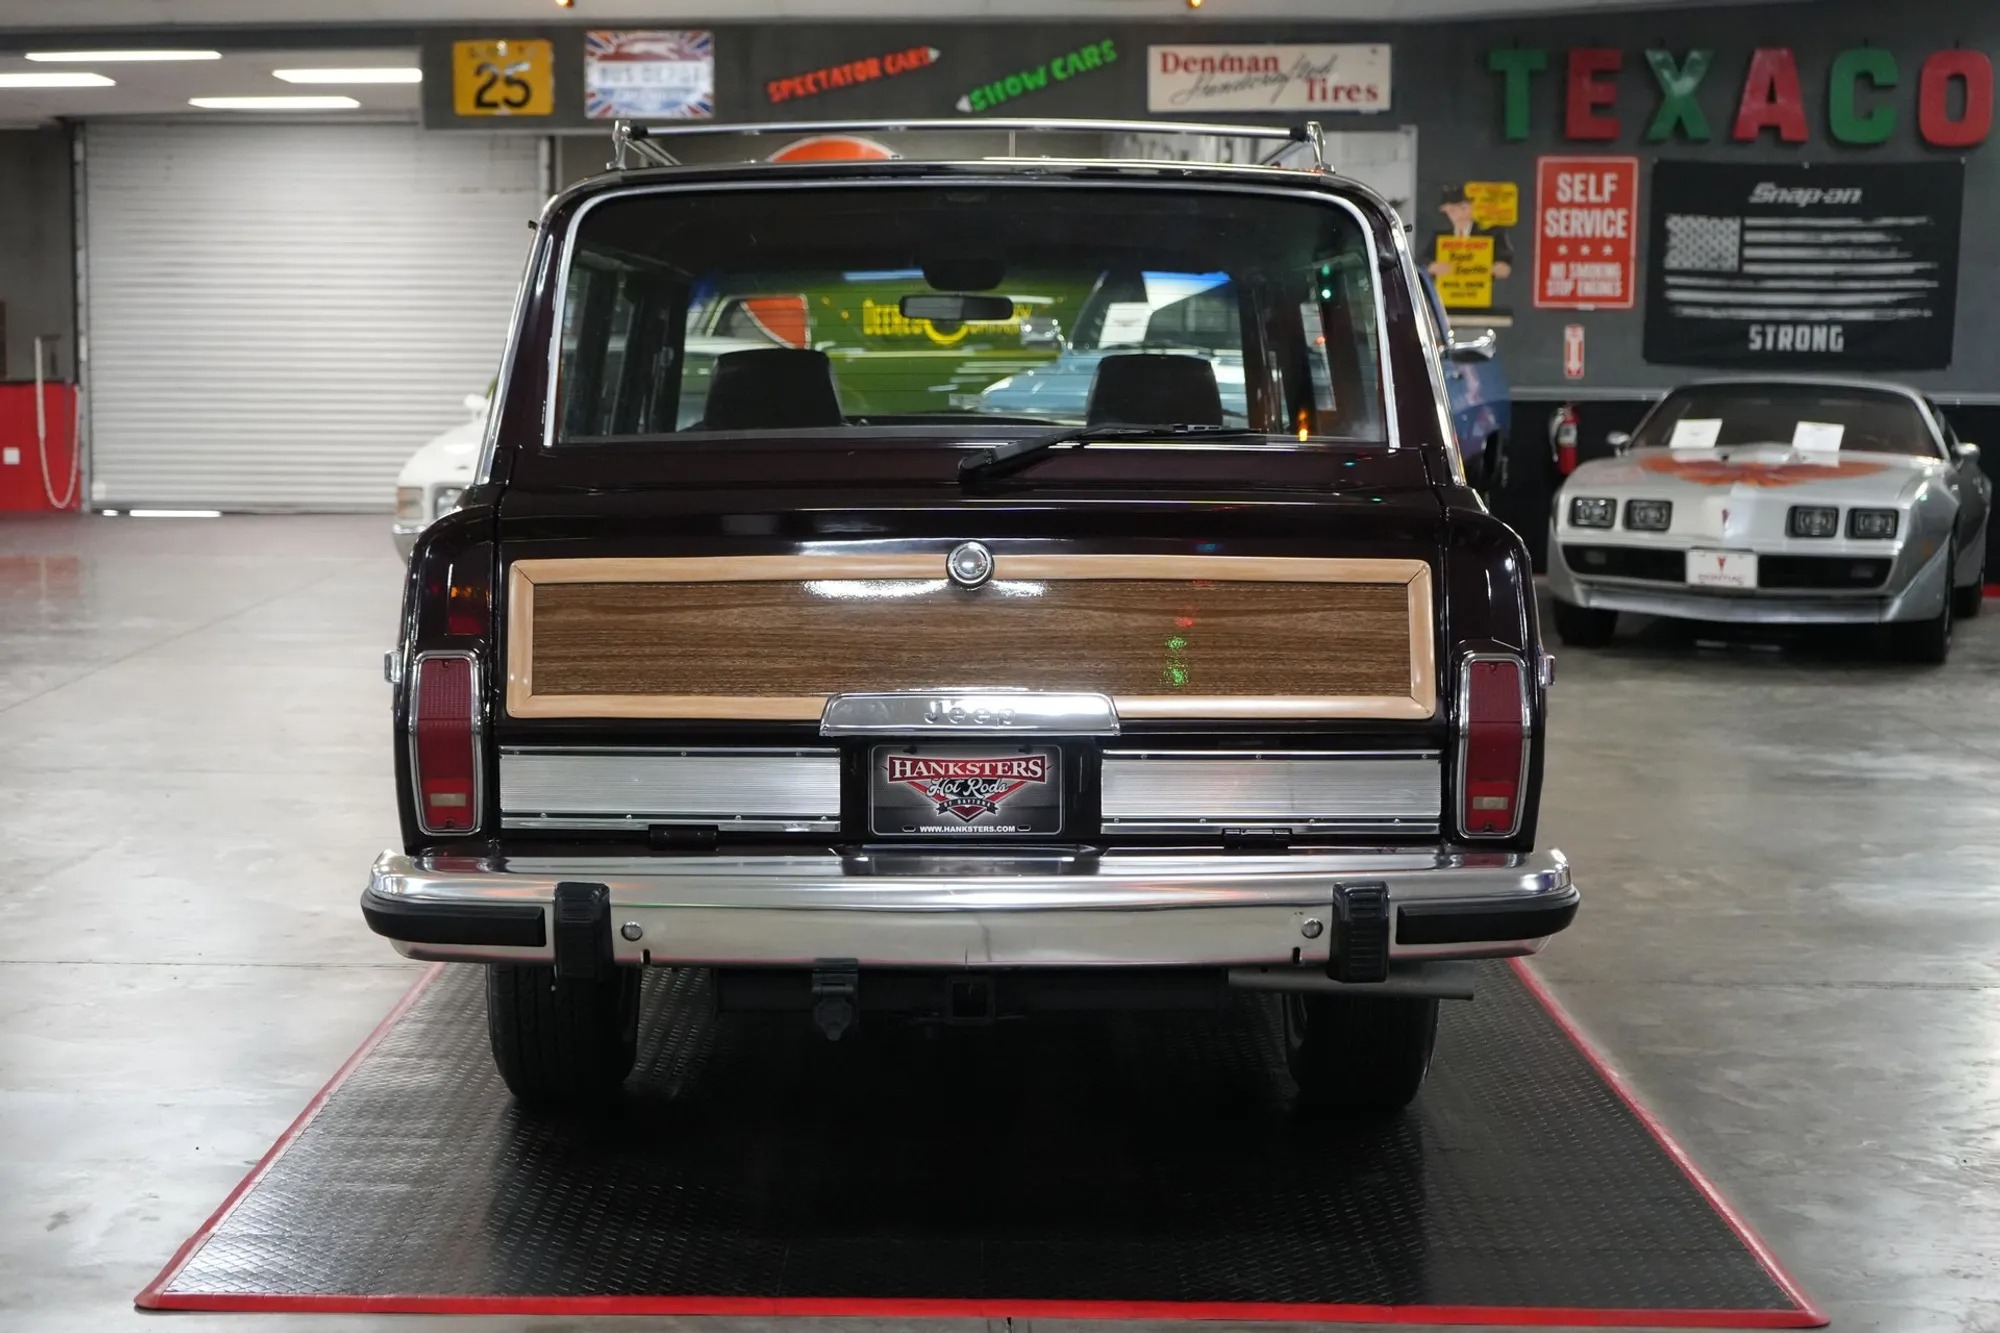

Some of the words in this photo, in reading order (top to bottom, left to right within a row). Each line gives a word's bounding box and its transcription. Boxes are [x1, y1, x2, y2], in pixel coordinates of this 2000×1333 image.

[767, 57, 882, 103] SPECTATOR
[884, 46, 931, 74] CARS
[970, 66, 1047, 111] SHOW
[1051, 39, 1118, 80] CARS
[1160, 51, 1279, 74] Denman
[474, 62, 532, 109] 25
[1304, 76, 1379, 102] Tires
[1488, 48, 1994, 146] TEXACO
[1556, 172, 1619, 203] SELF
[1748, 182, 1863, 208] Snap-on
[1545, 207, 1629, 239] SERVICE
[1748, 323, 1844, 352] STRONG
[924, 701, 1016, 726] Jeep
[893, 758, 1043, 779] HANKSTERS
[926, 777, 963, 797] Hot
[963, 777, 1009, 799] Rods
[919, 825, 1016, 834] WWW.HANKSTERS.COM
